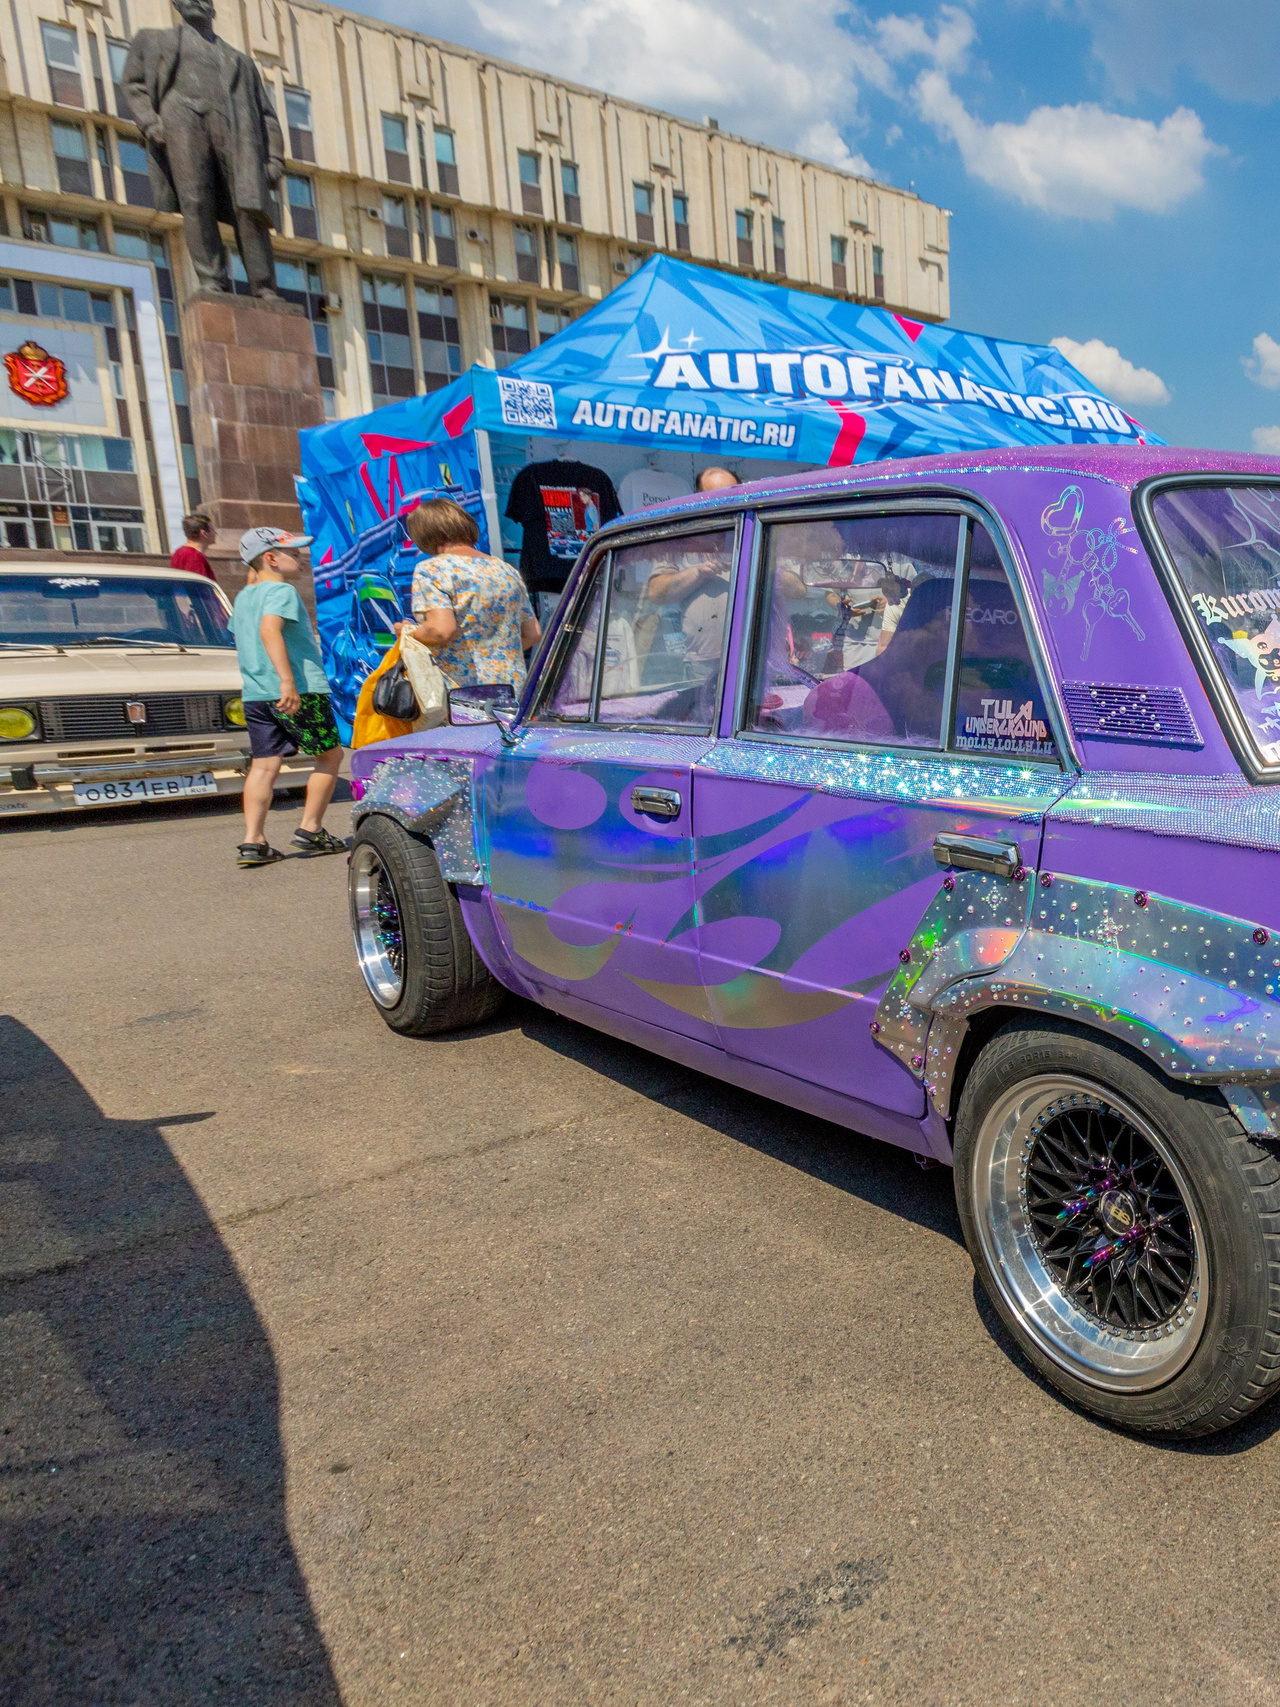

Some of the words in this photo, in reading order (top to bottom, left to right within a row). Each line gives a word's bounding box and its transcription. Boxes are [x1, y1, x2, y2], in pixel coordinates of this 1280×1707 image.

[652, 350, 1132, 435] AUTOFANATIC.RU
[571, 399, 796, 448] AUTOFANATIC.RU
[965, 716, 1048, 741] UNDERGROUND
[981, 699, 1033, 726] TULA
